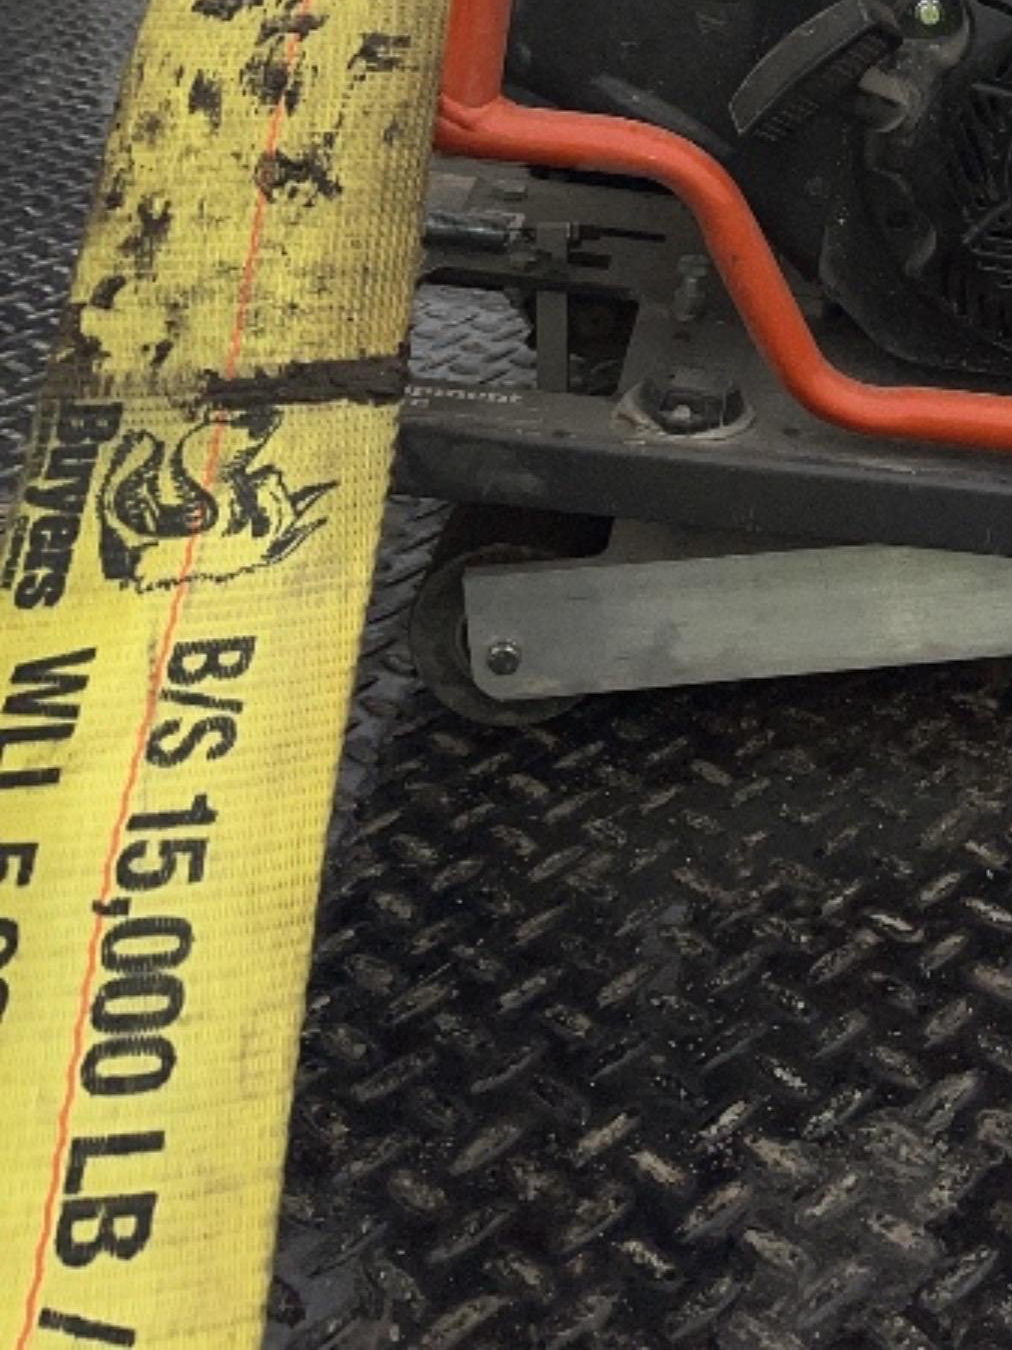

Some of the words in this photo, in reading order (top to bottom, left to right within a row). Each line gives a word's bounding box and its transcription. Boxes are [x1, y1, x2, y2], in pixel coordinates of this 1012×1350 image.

[13, 402, 124, 610] Buyers
[144, 635, 257, 768] B/S
[79, 793, 218, 1097] 15,000
[54, 1130, 166, 1269] LB
